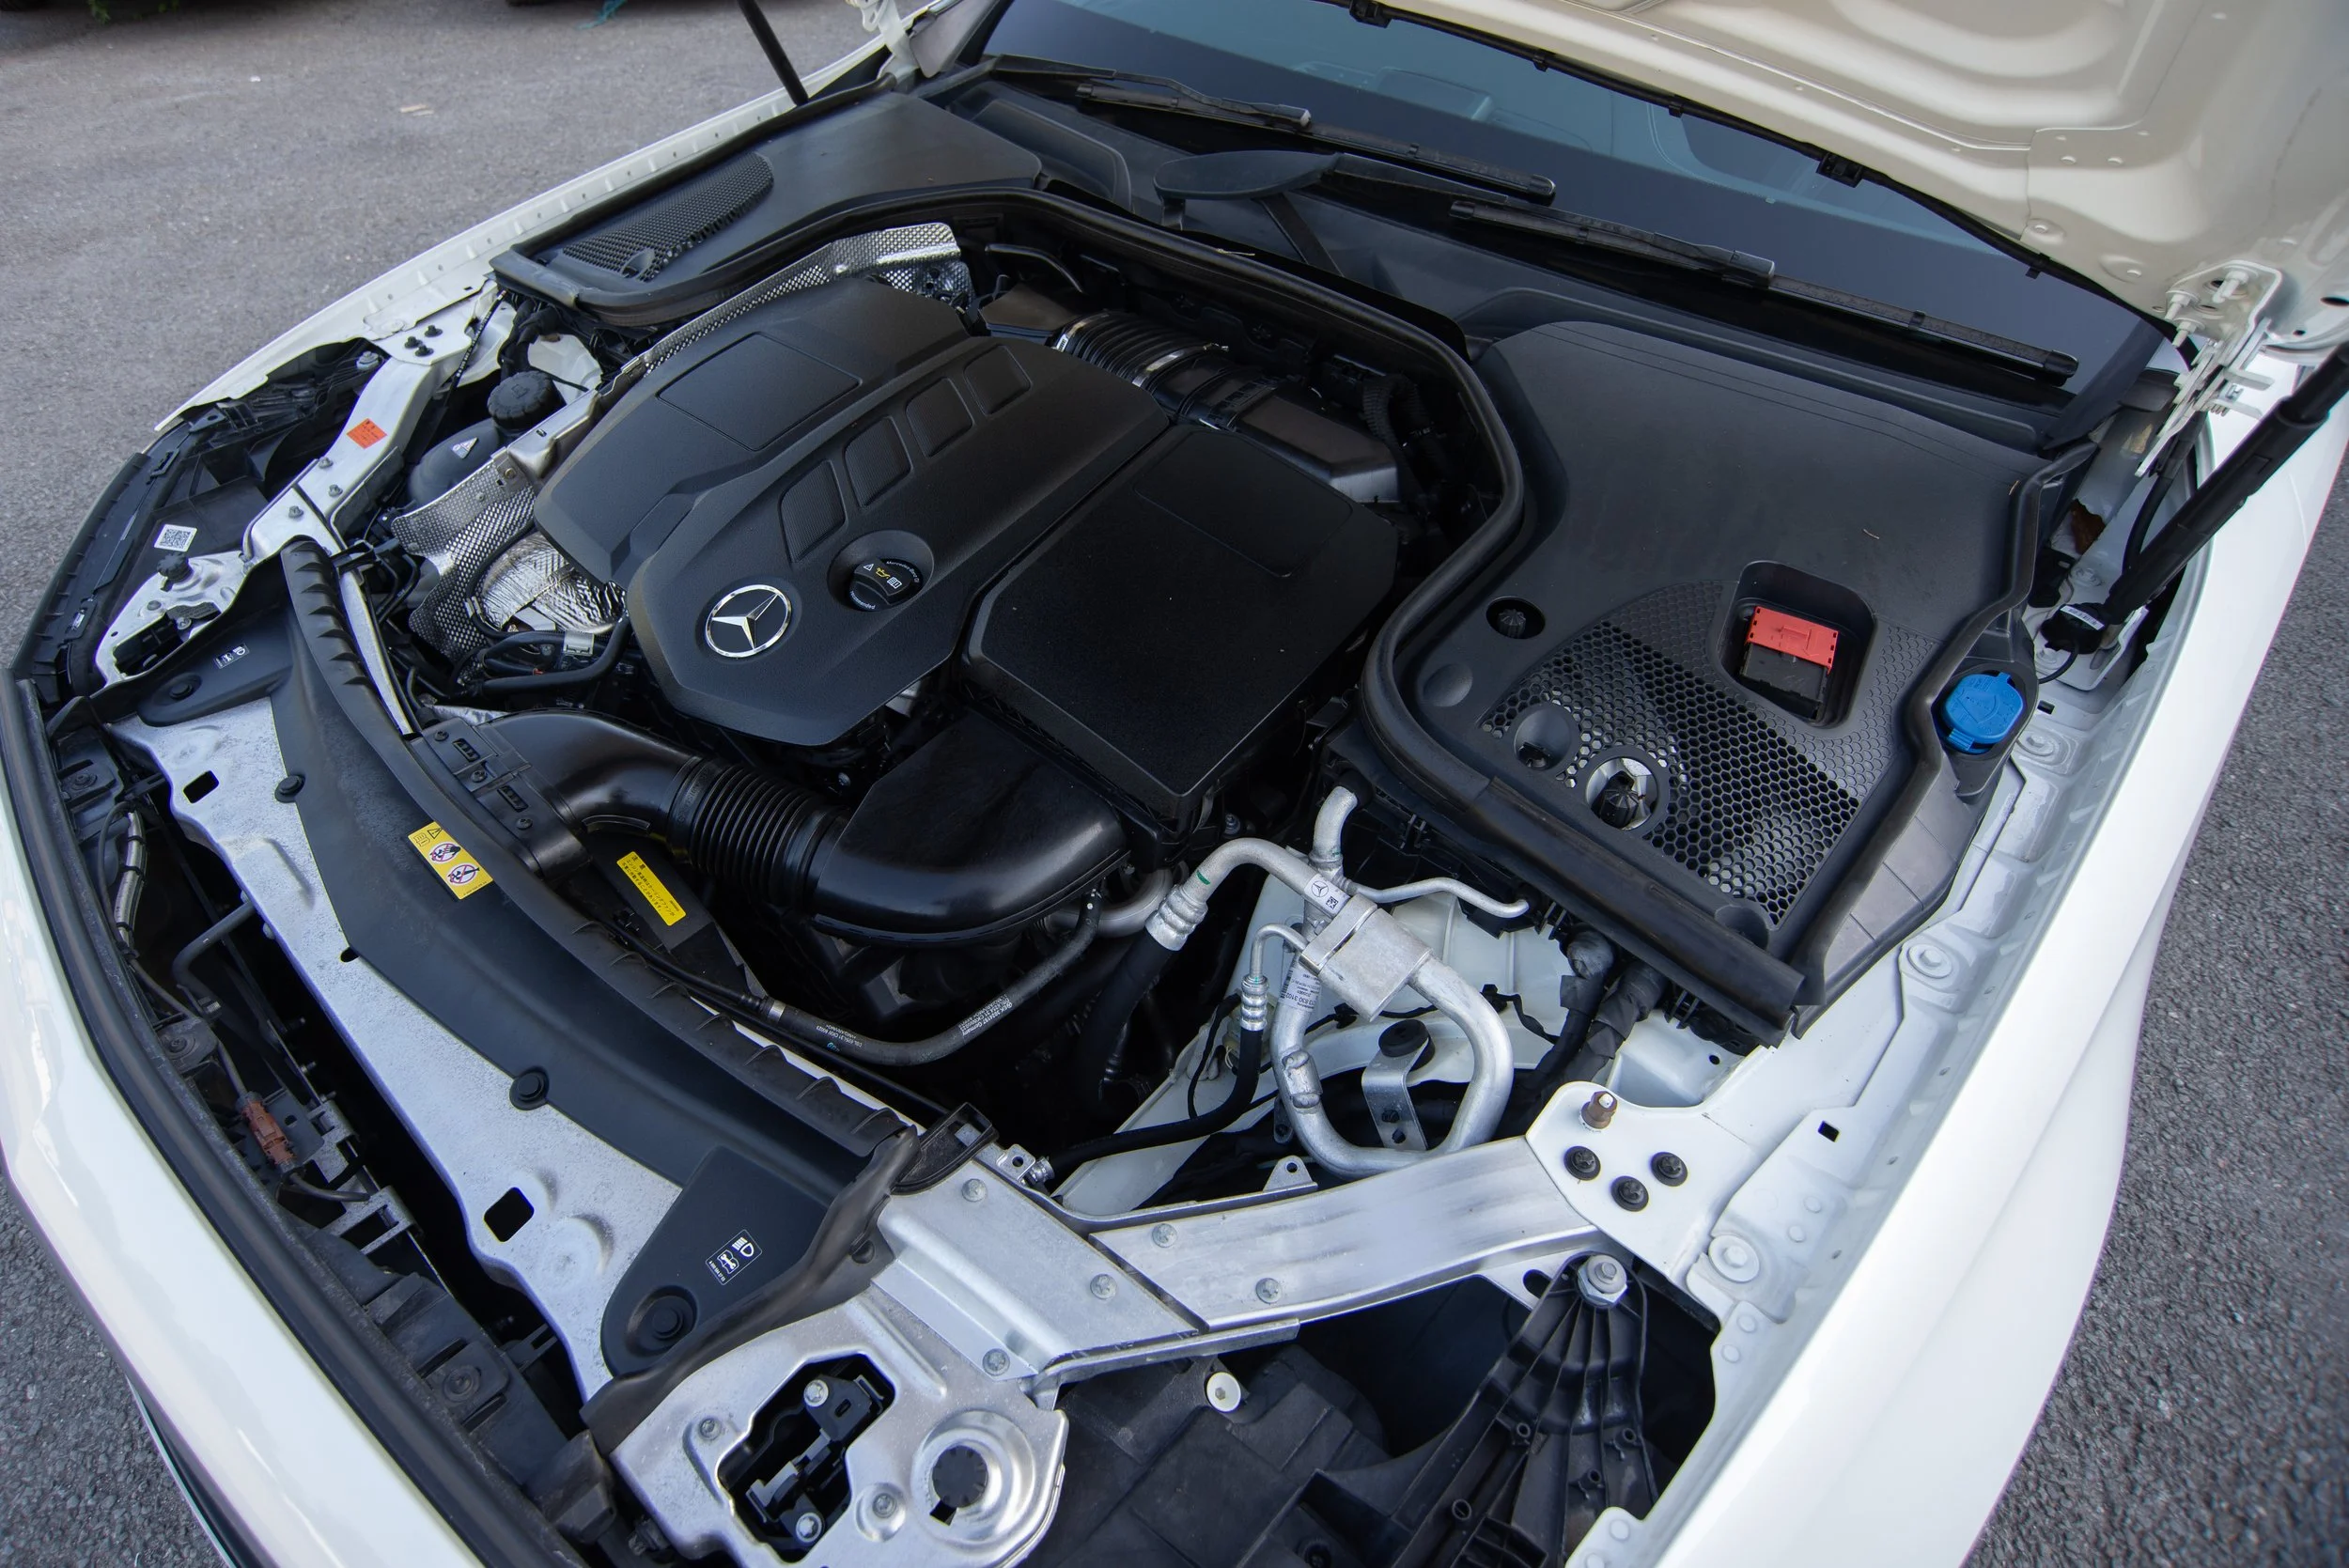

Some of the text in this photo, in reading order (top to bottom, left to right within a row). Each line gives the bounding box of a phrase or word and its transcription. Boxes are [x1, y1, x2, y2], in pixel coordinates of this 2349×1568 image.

[849, 590, 876, 610] recommended
[1285, 992, 1299, 1001] 3102
[962, 1021, 983, 1036] Germany
